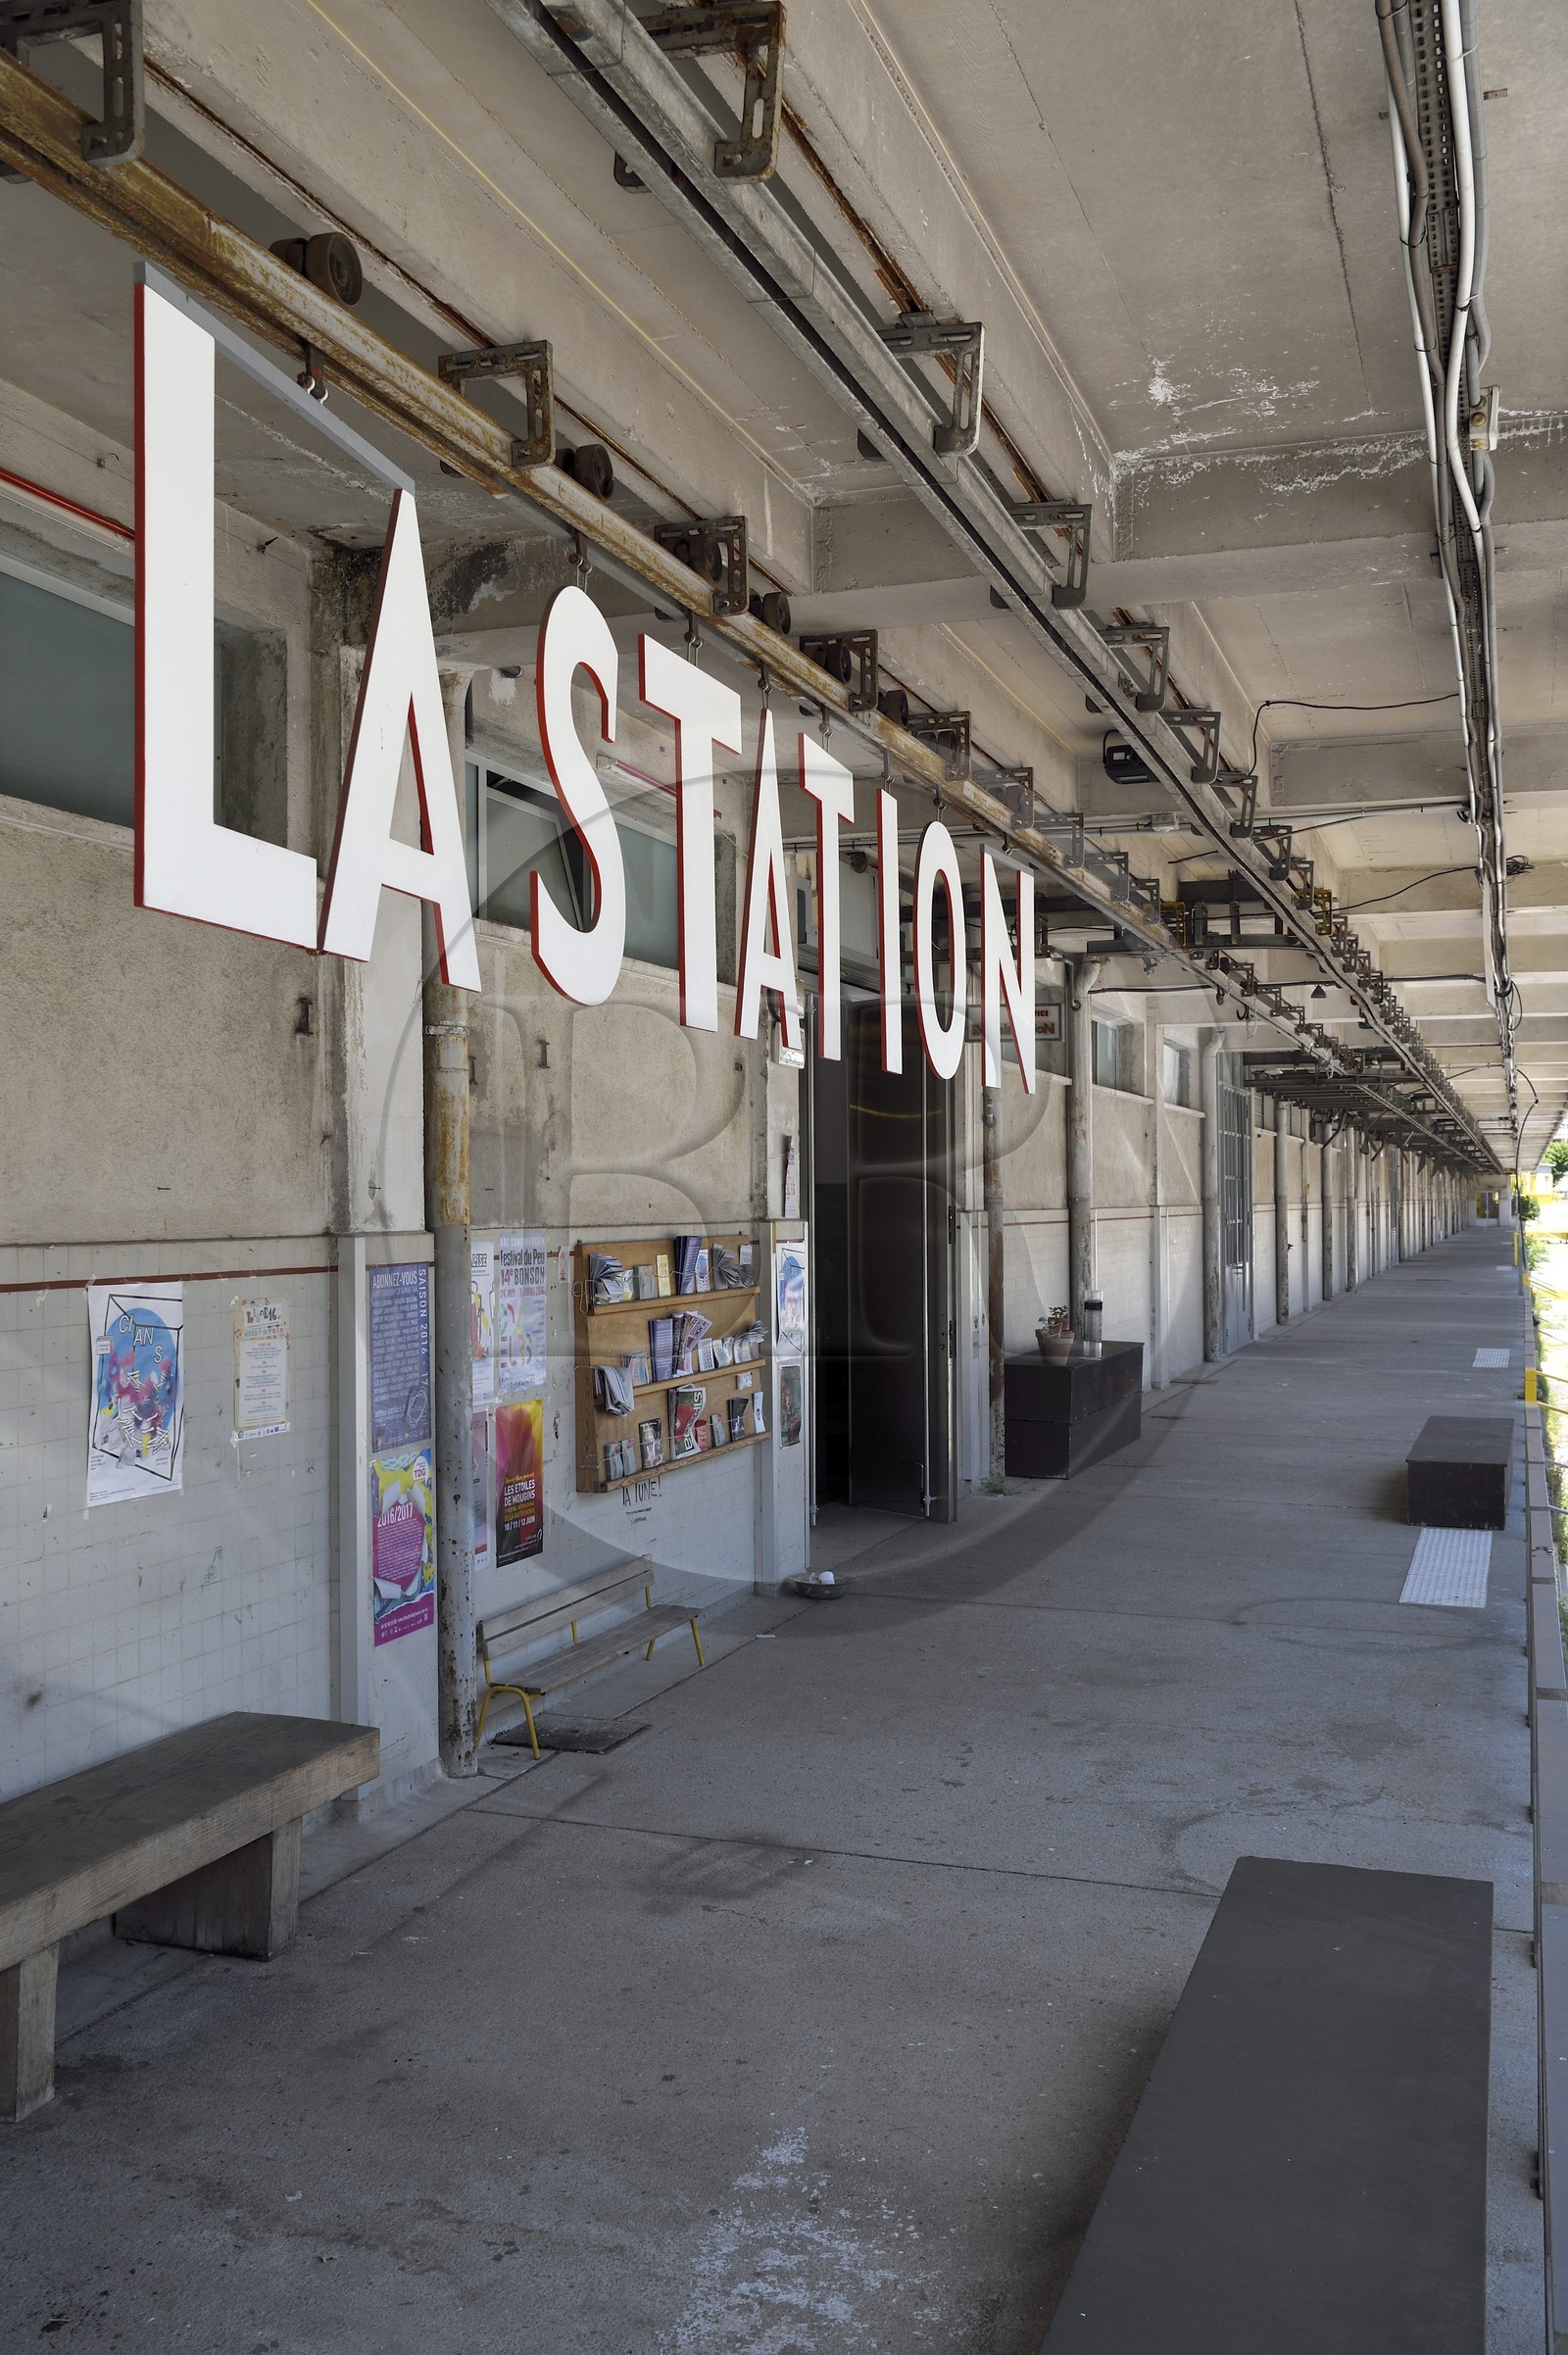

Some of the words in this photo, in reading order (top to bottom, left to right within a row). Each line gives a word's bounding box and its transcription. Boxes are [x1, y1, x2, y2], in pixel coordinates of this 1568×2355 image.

[134, 280, 480, 993] LA
[530, 586, 1036, 1094] STATION
[500, 1250, 523, 1267] Festival
[523, 1249, 532, 1265] du
[372, 1270, 418, 1289] ABONNEZ-VOUS
[514, 1266, 545, 1286] BONSON
[418, 1268, 427, 1317] SAISON
[419, 1324, 428, 1354] 2016
[421, 1371, 428, 1386] 17
[414, 1467, 426, 1478] TDG
[504, 1485, 514, 1496] LES
[514, 1479, 536, 1494] ETOILES
[504, 1496, 513, 1507] DE
[512, 1489, 536, 1505] MOUGINS
[377, 1502, 414, 1528] 2016/2017
